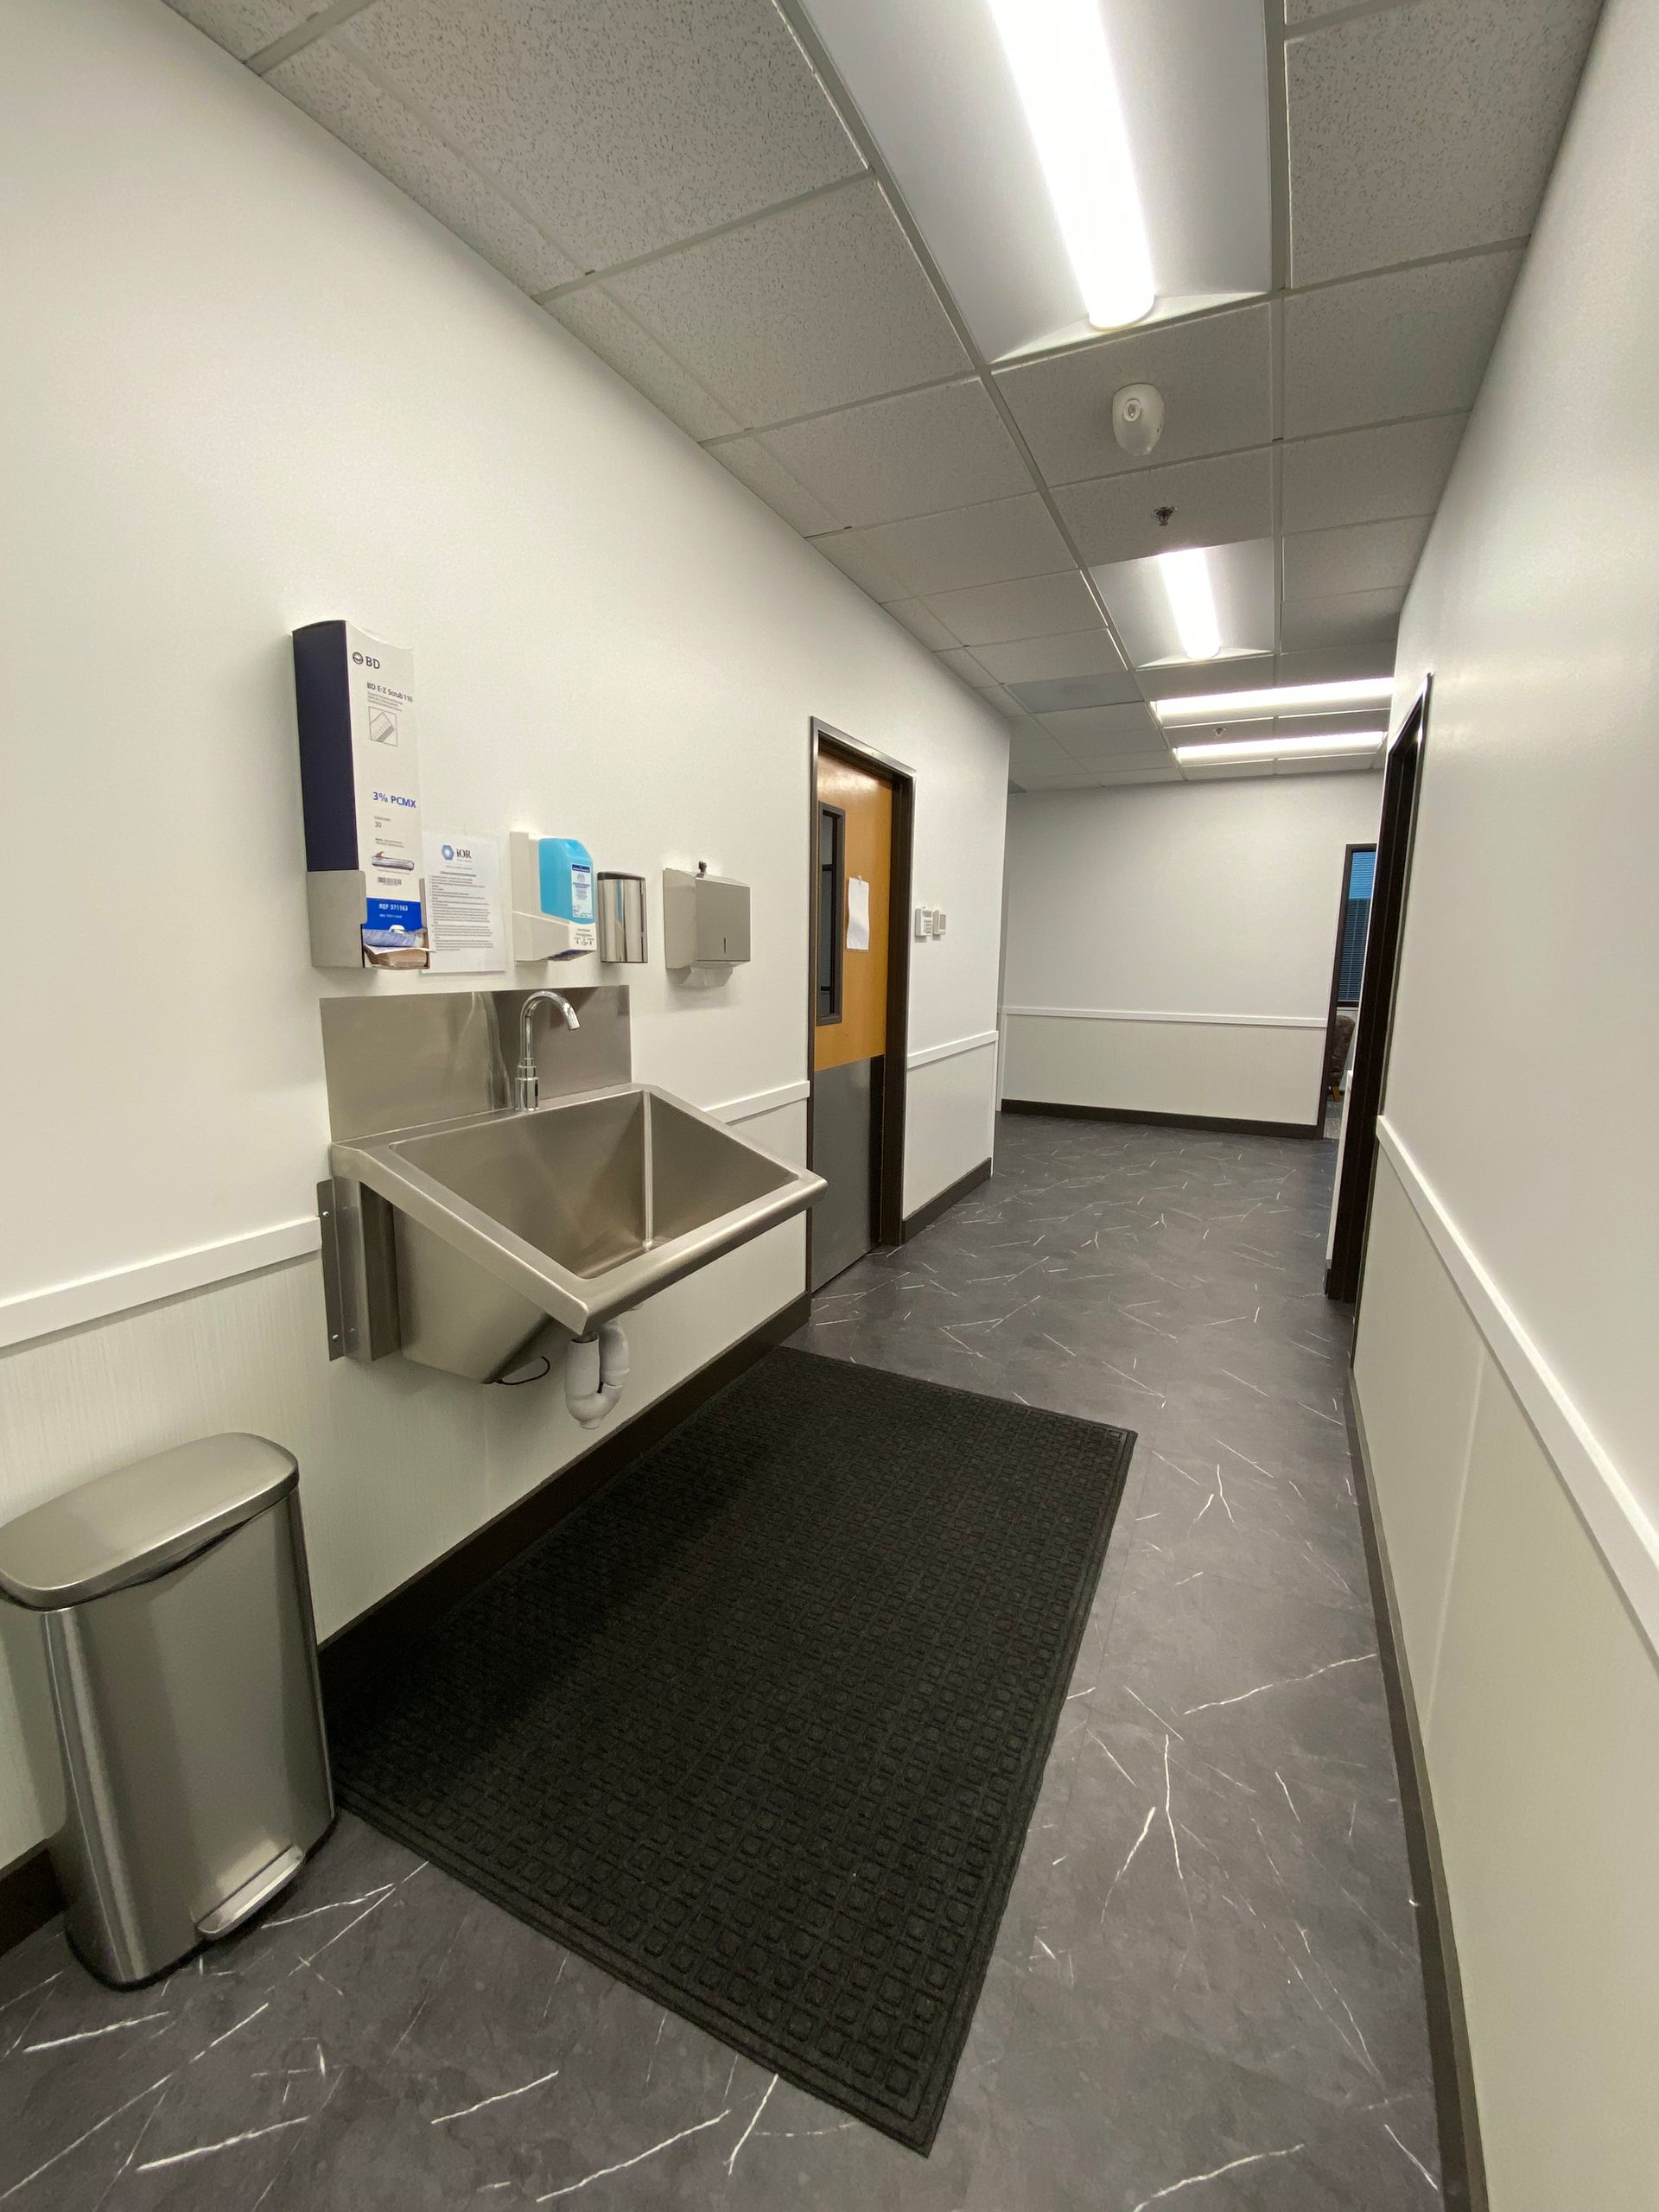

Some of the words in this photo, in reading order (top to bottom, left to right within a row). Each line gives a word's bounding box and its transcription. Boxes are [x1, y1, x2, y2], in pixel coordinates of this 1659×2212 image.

[365, 656, 380, 669] BD
[388, 689, 403, 699] Scrub
[372, 791, 388, 802] 3%
[391, 795, 416, 808] PCMX
